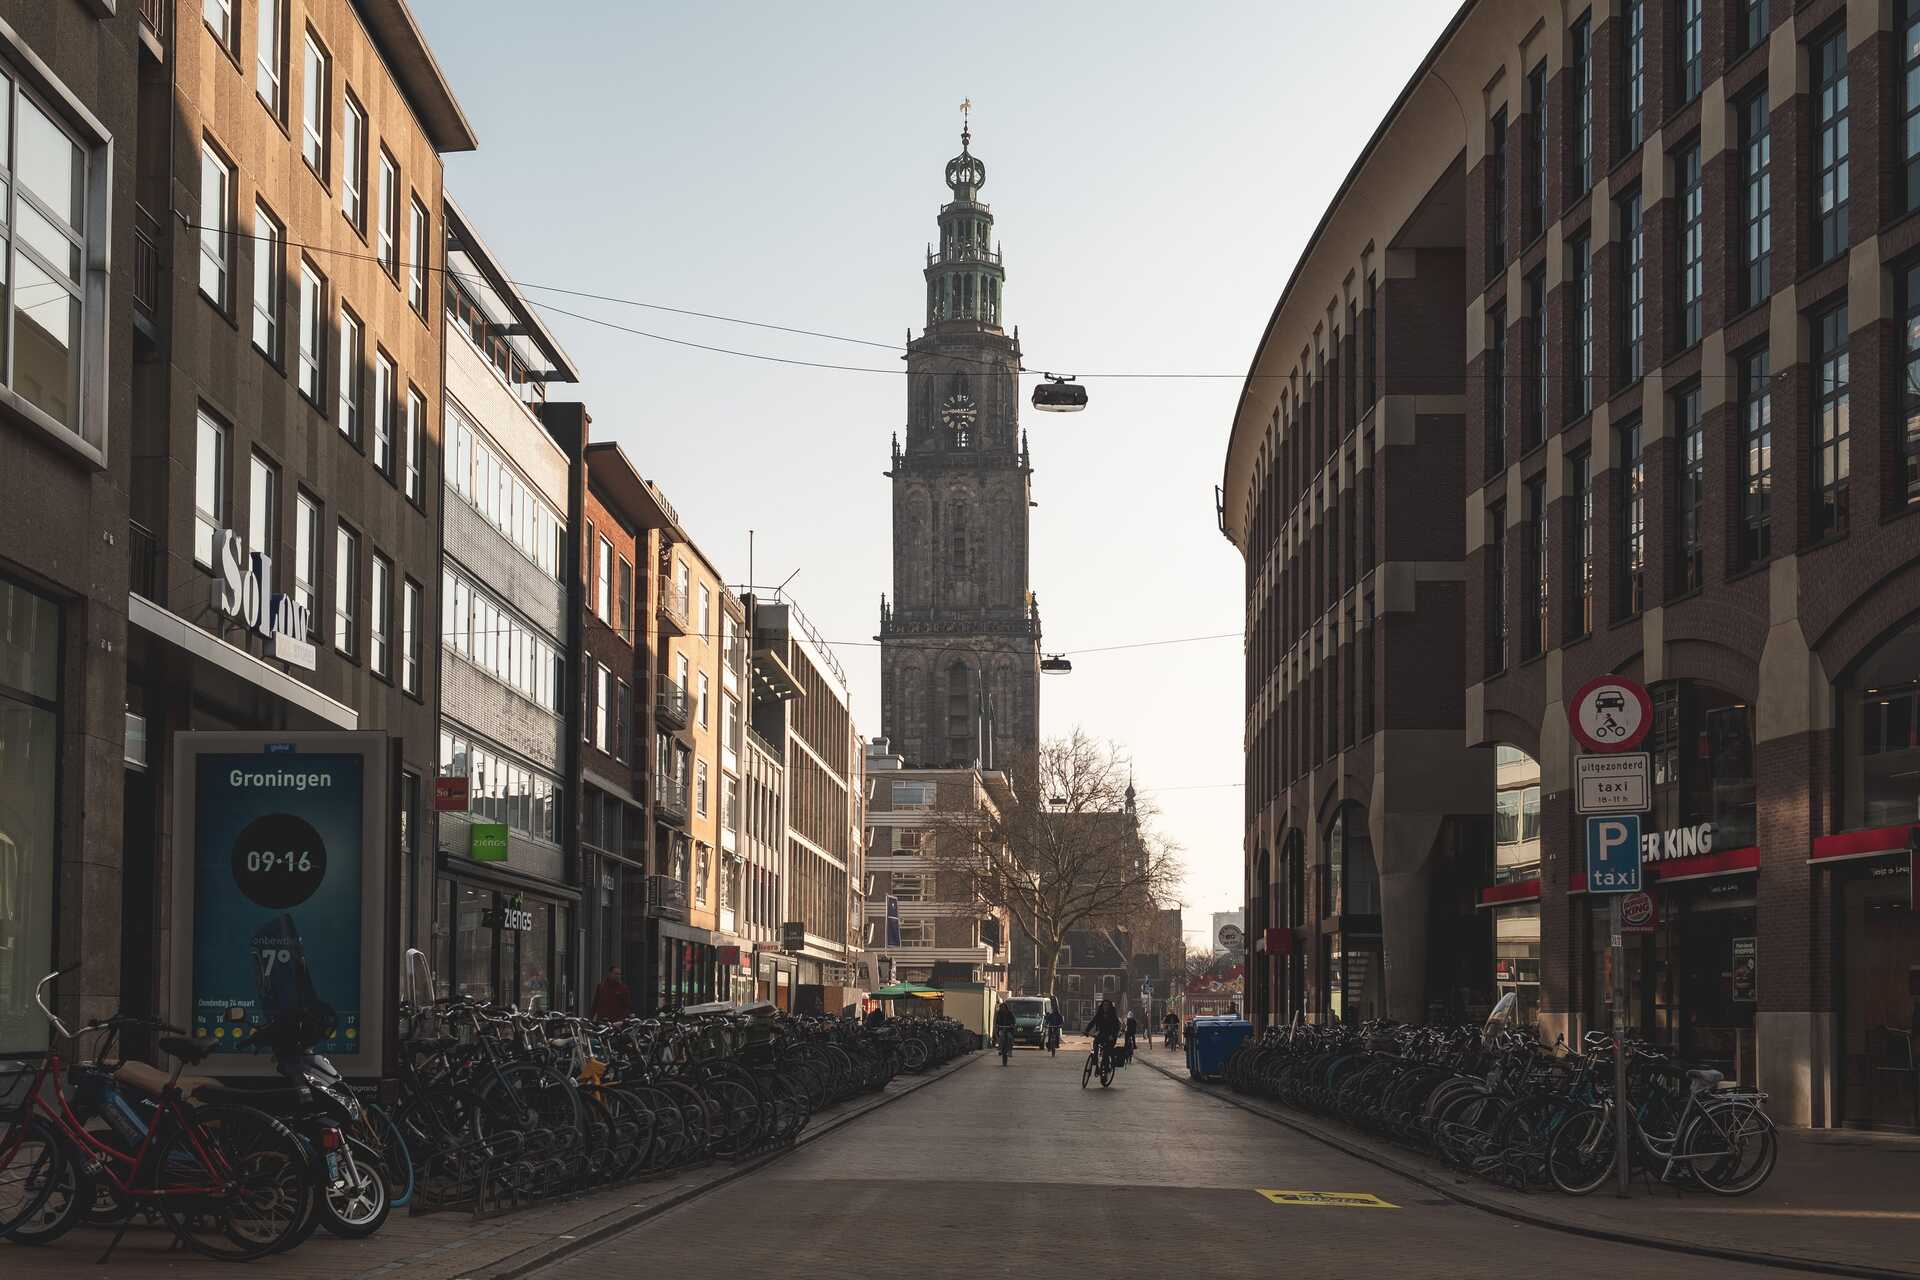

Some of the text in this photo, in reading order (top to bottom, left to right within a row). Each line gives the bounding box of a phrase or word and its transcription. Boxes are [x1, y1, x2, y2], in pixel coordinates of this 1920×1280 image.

[1582, 760, 1643, 773] uitgezonderd
[230, 769, 332, 791] Groningen
[1598, 782, 1628, 792] taxi
[1599, 822, 1628, 861] P
[1664, 822, 1712, 858] KING
[1594, 869, 1636, 886] taxi
